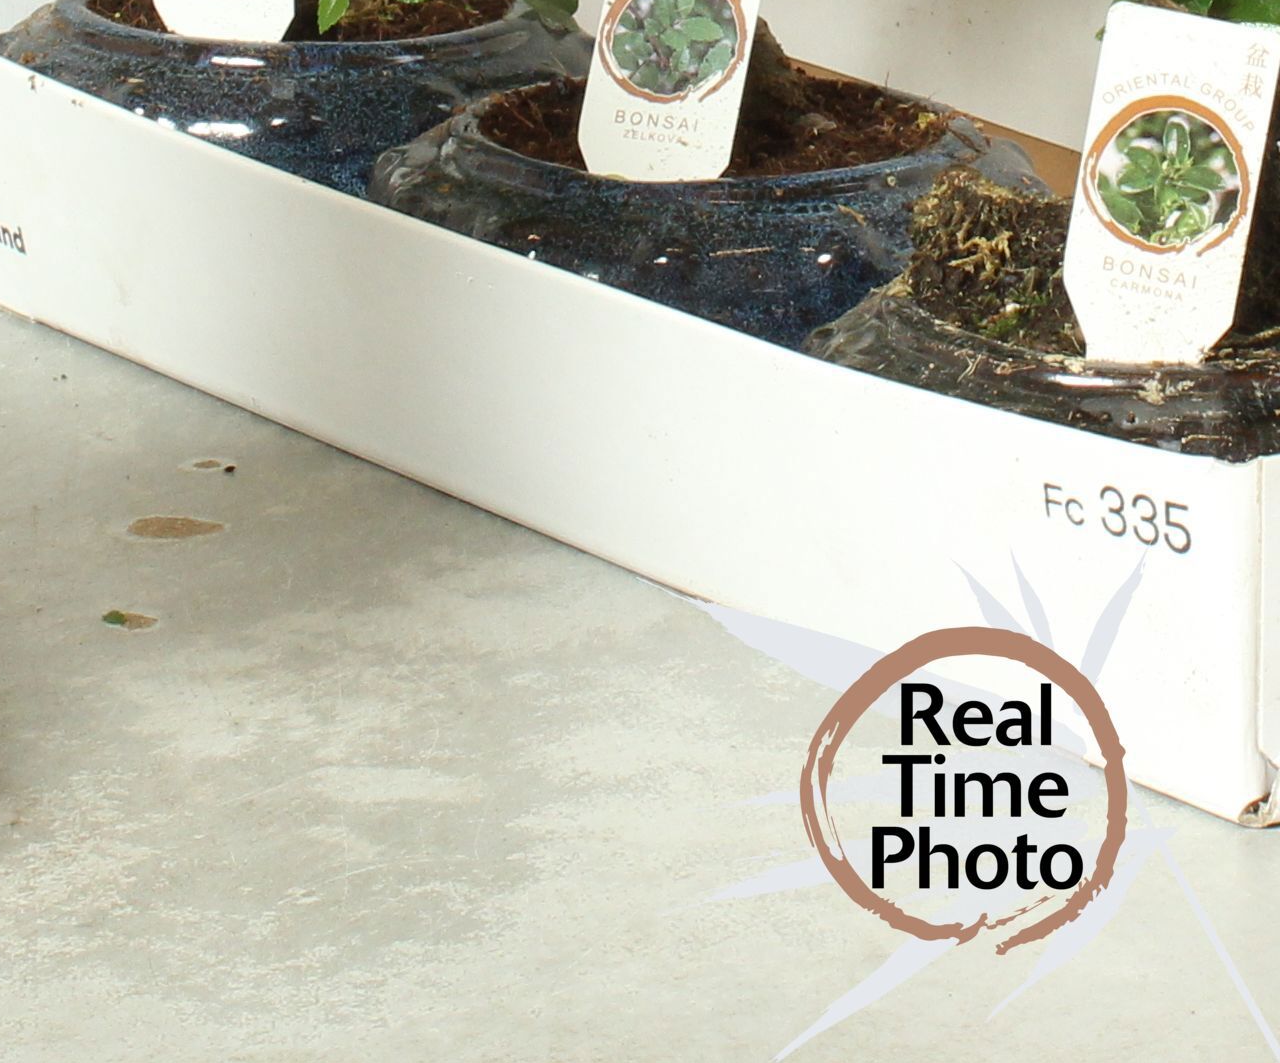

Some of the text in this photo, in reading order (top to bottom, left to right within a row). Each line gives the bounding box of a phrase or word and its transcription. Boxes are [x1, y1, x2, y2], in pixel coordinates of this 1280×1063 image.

[1239, 42, 1270, 99] 盆栽
[614, 109, 699, 132] BONSAI
[1102, 72, 1255, 132] ORIENTAL GROUP
[1103, 256, 1197, 289] BONSAI
[1110, 278, 1183, 302] CARMONA
[1043, 483, 1192, 554] Fc 335
